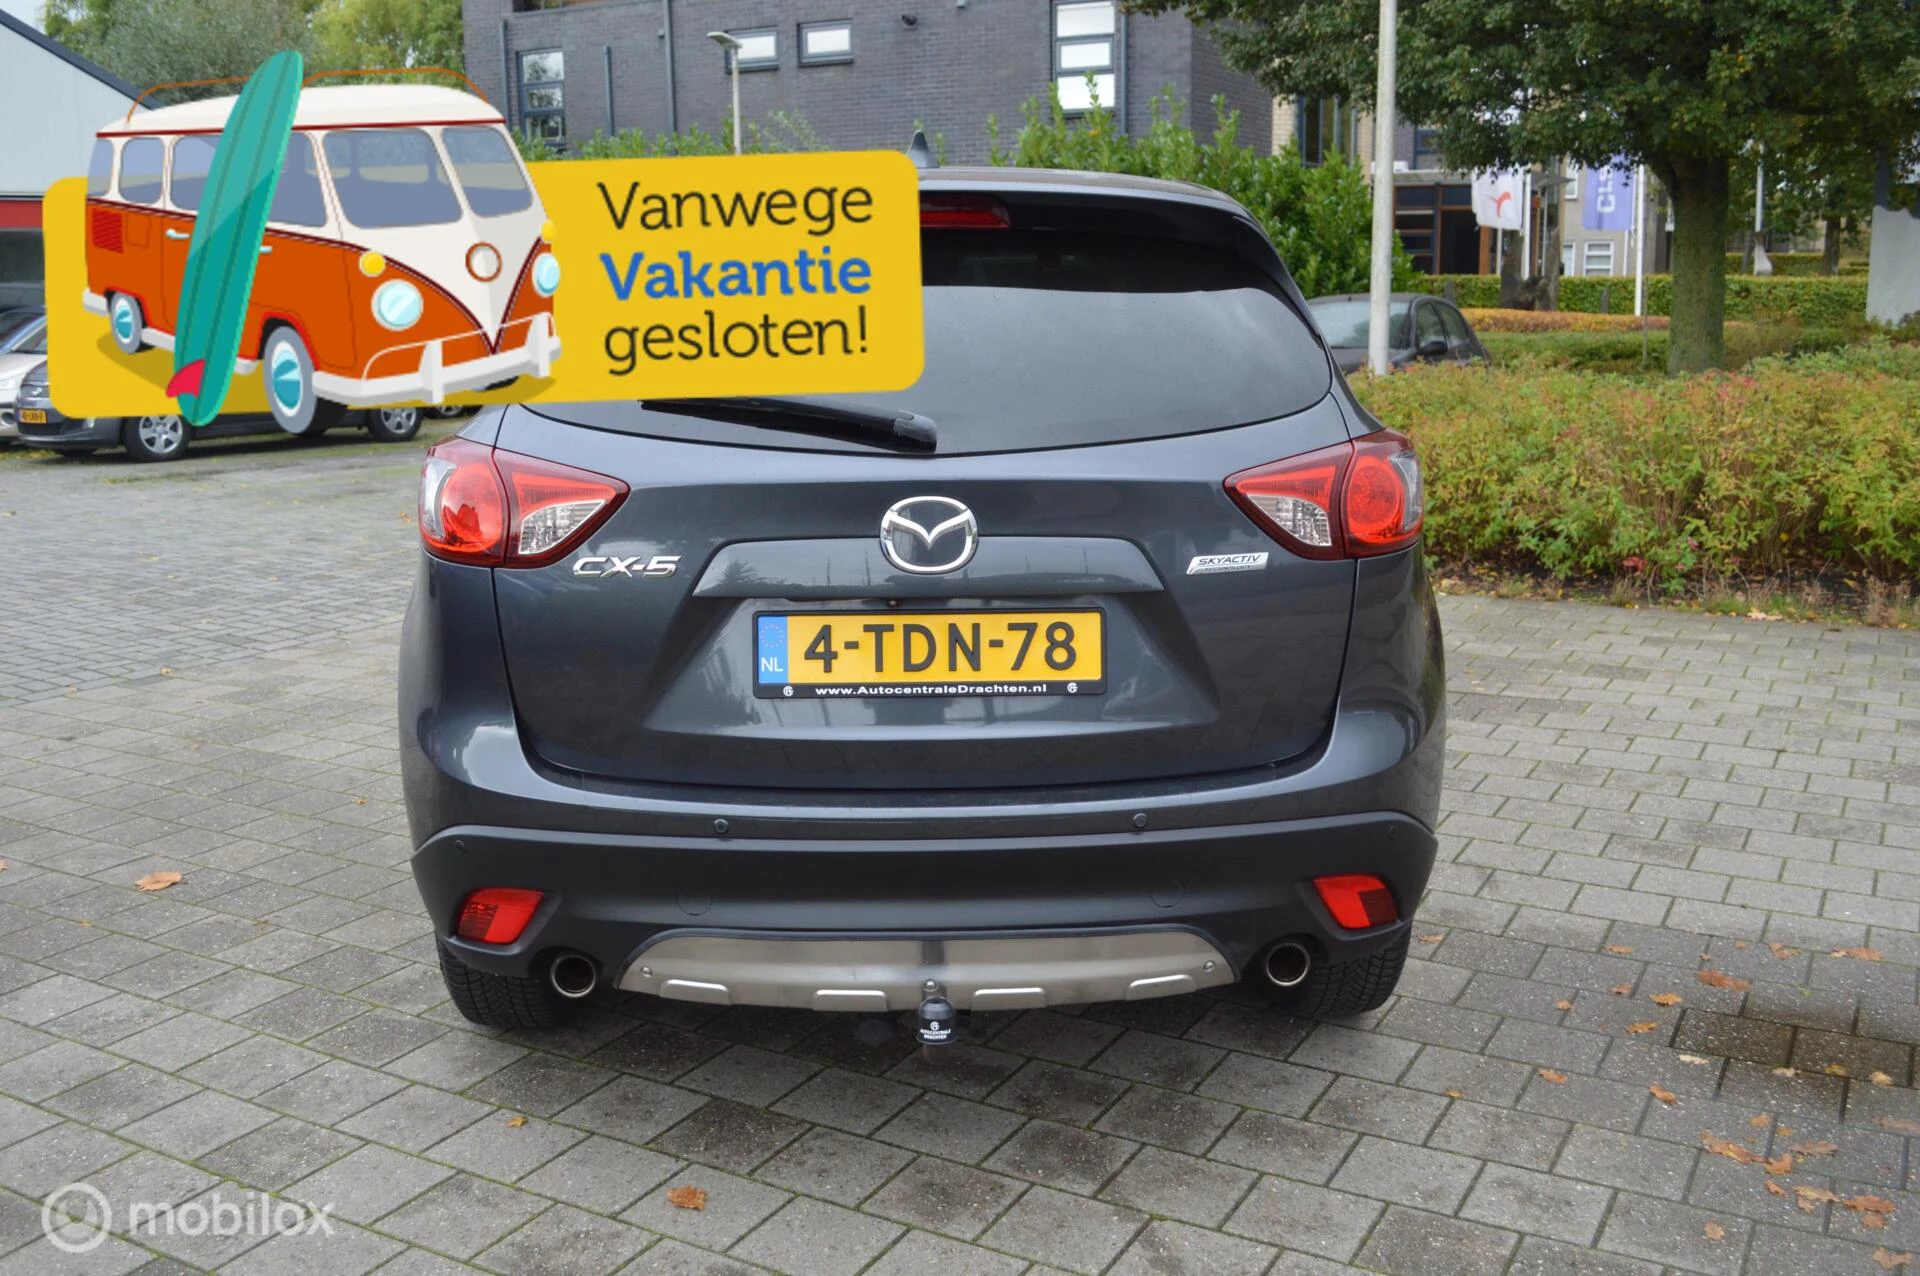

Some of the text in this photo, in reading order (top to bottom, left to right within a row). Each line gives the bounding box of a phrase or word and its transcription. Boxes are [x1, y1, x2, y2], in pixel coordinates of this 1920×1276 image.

[572, 556, 681, 578] CX-5
[1197, 554, 1261, 566] SKYACTIV
[804, 621, 1077, 673] 4-TDN-78
[761, 657, 784, 673] NL
[815, 683, 1047, 696] www.AutocentraleDrachten.nl
